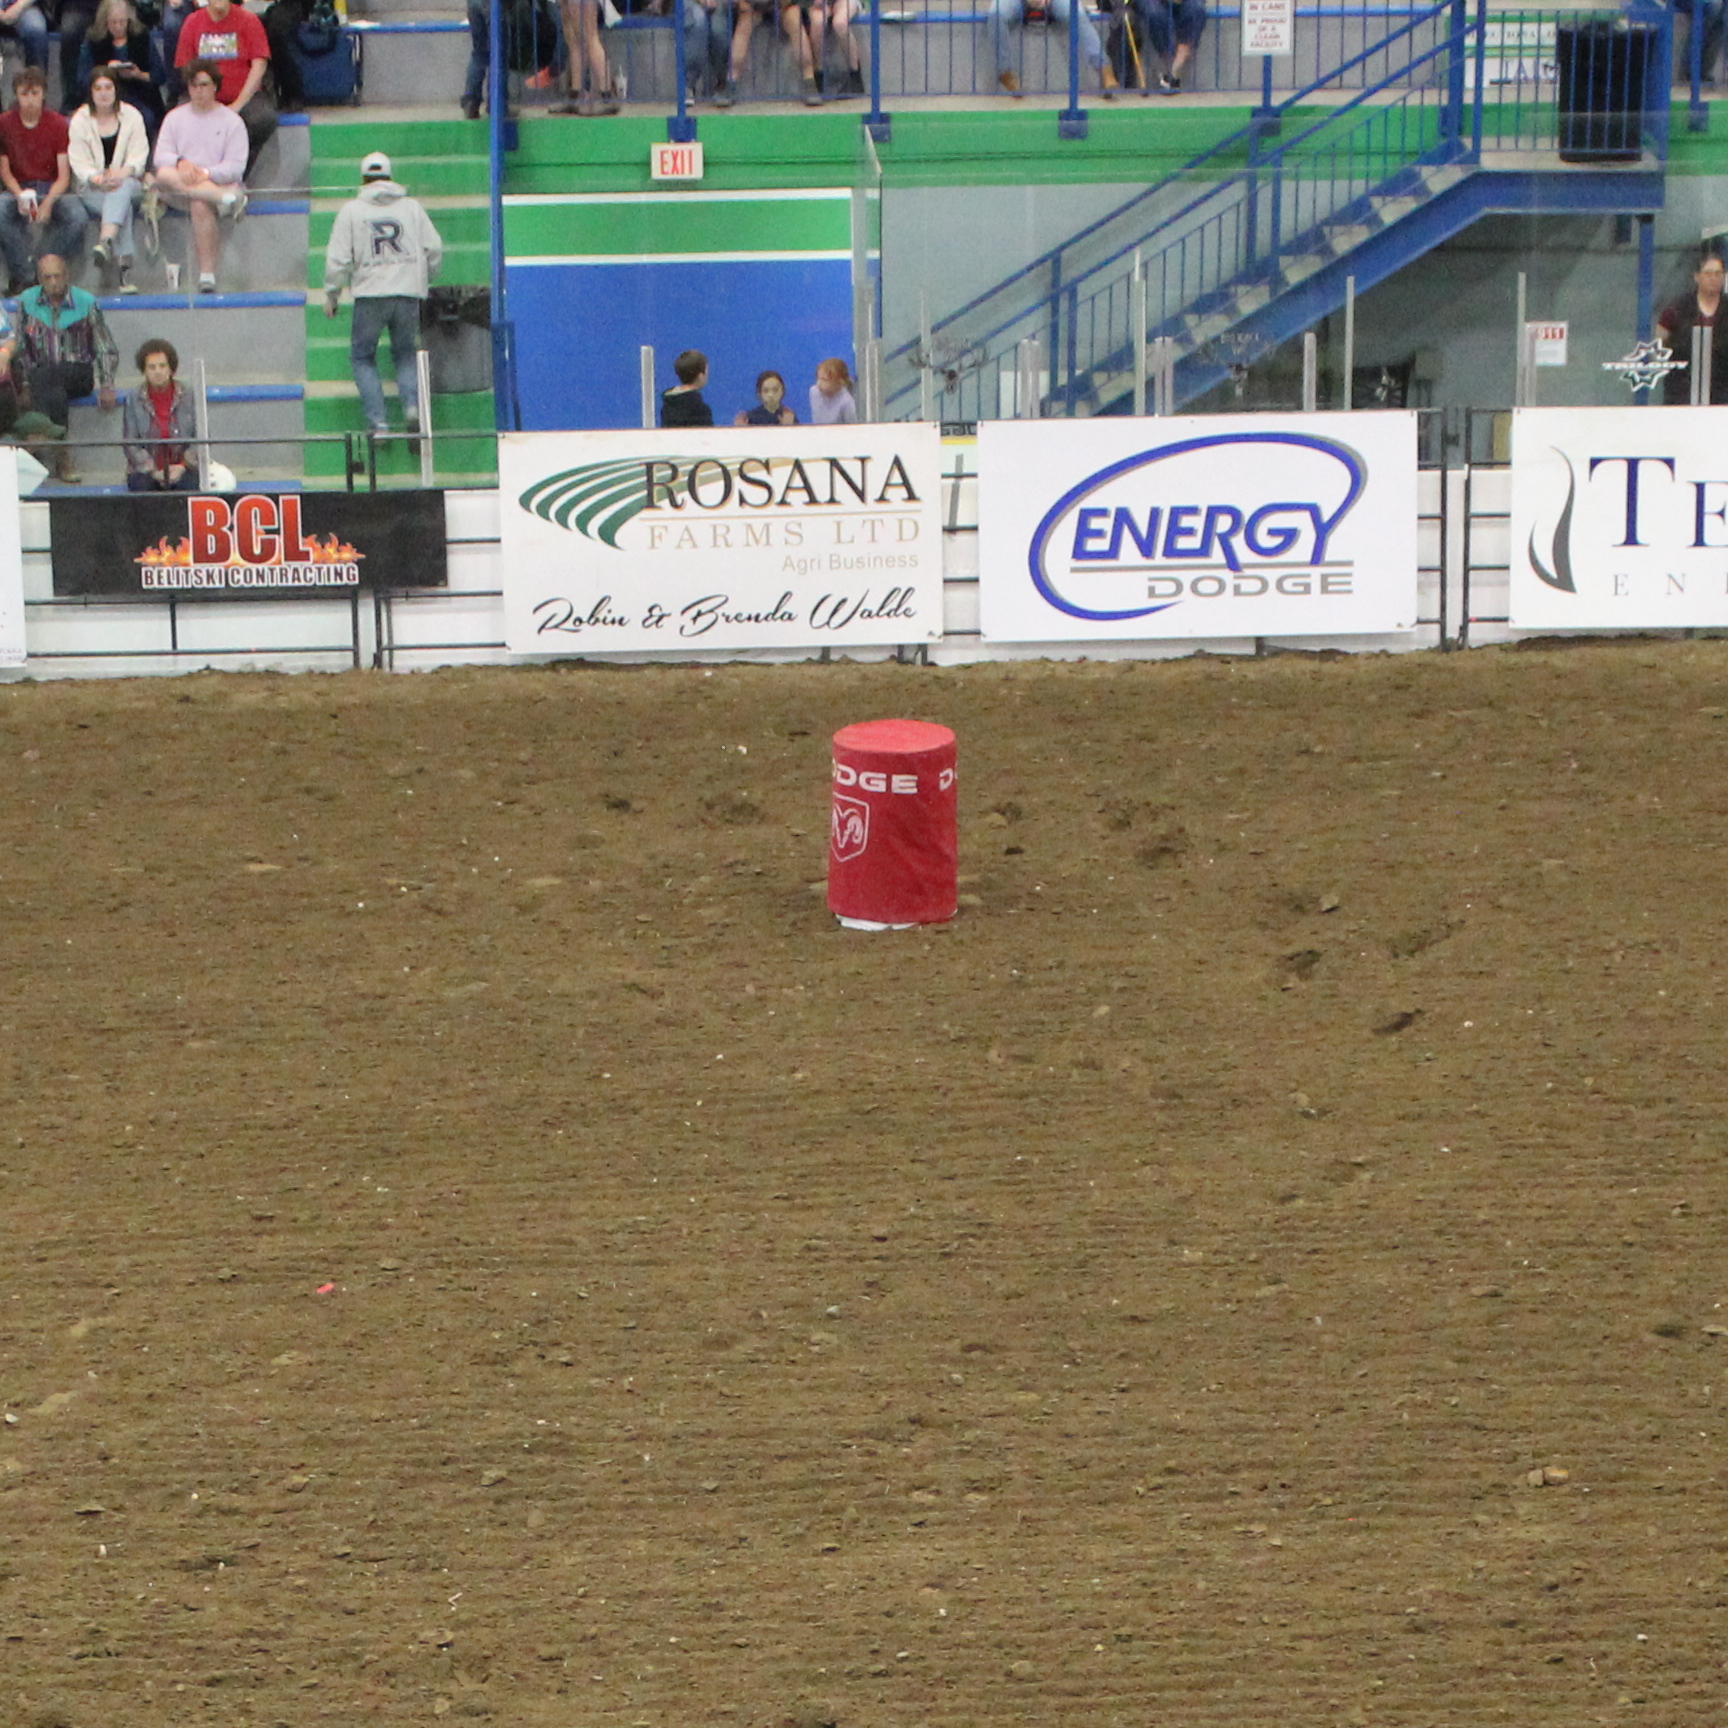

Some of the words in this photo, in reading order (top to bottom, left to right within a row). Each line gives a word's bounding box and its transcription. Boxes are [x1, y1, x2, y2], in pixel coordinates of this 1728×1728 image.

[660, 149, 694, 175] EXIT
[641, 453, 922, 511] ROSANA
[187, 494, 314, 566] BCL
[647, 521, 805, 551] FARMS
[833, 517, 920, 545] LTD
[1071, 501, 1334, 573] ENERGY
[141, 565, 226, 589] BELITSKI
[228, 563, 360, 588] CONTRACTING
[782, 554, 822, 575] Agri
[828, 552, 920, 571] Business
[1147, 572, 1354, 599] DODGE
[532, 594, 630, 636] Robin
[679, 591, 798, 638] Brenda
[809, 586, 917, 630] Walde
